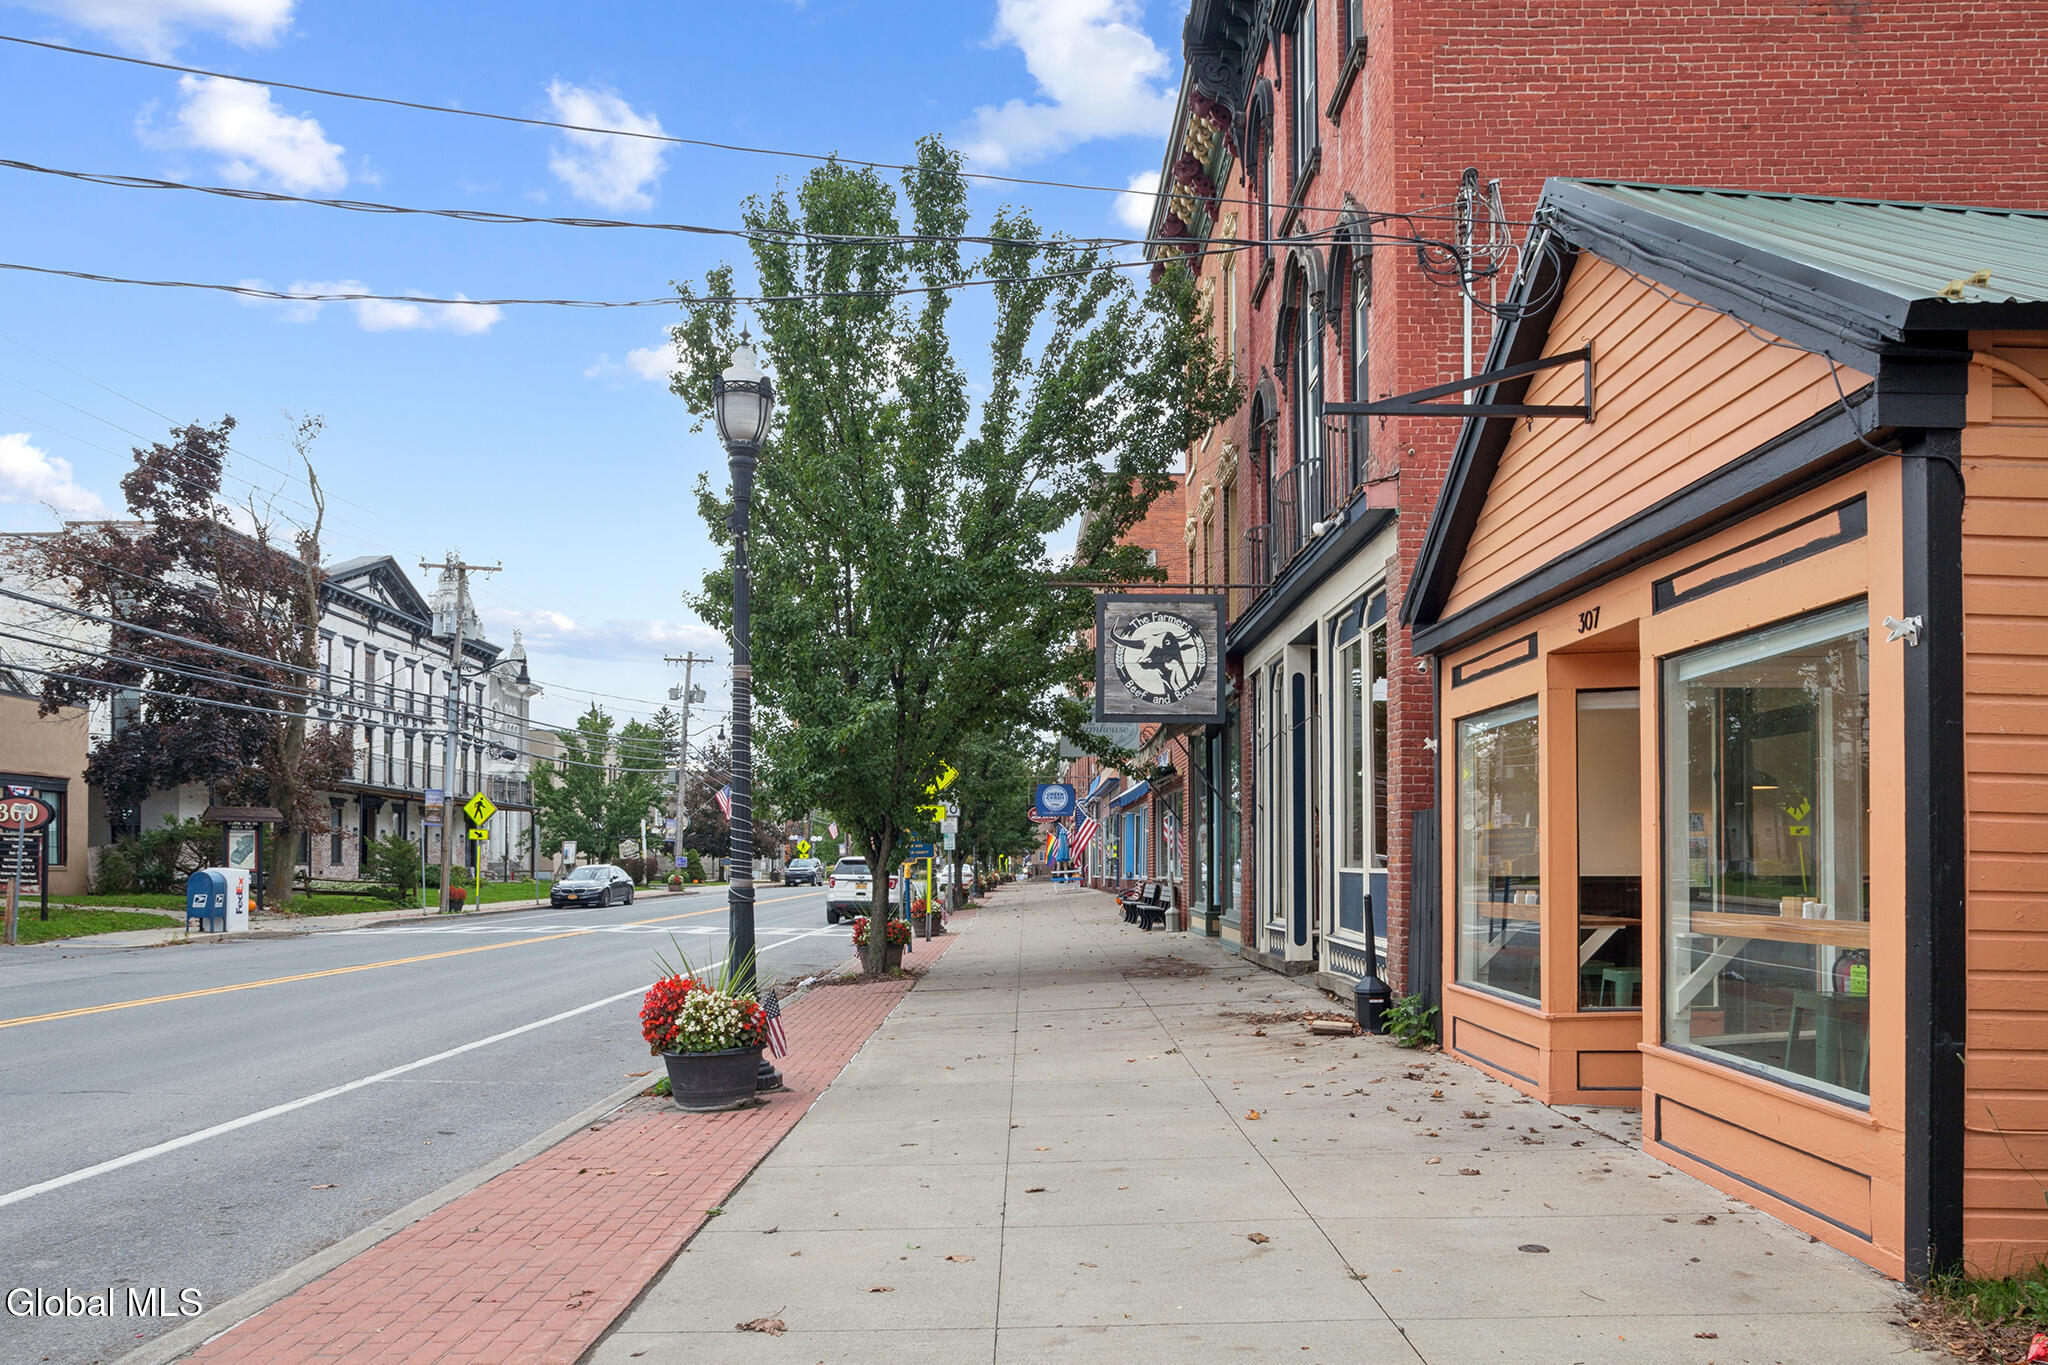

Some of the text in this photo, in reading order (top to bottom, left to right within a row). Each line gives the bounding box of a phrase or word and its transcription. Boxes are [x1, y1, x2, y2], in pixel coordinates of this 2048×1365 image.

[1129, 612, 1193, 632] The Farmers
[1578, 606, 1600, 633] 307
[1124, 680, 1199, 705] Beef and Brew
